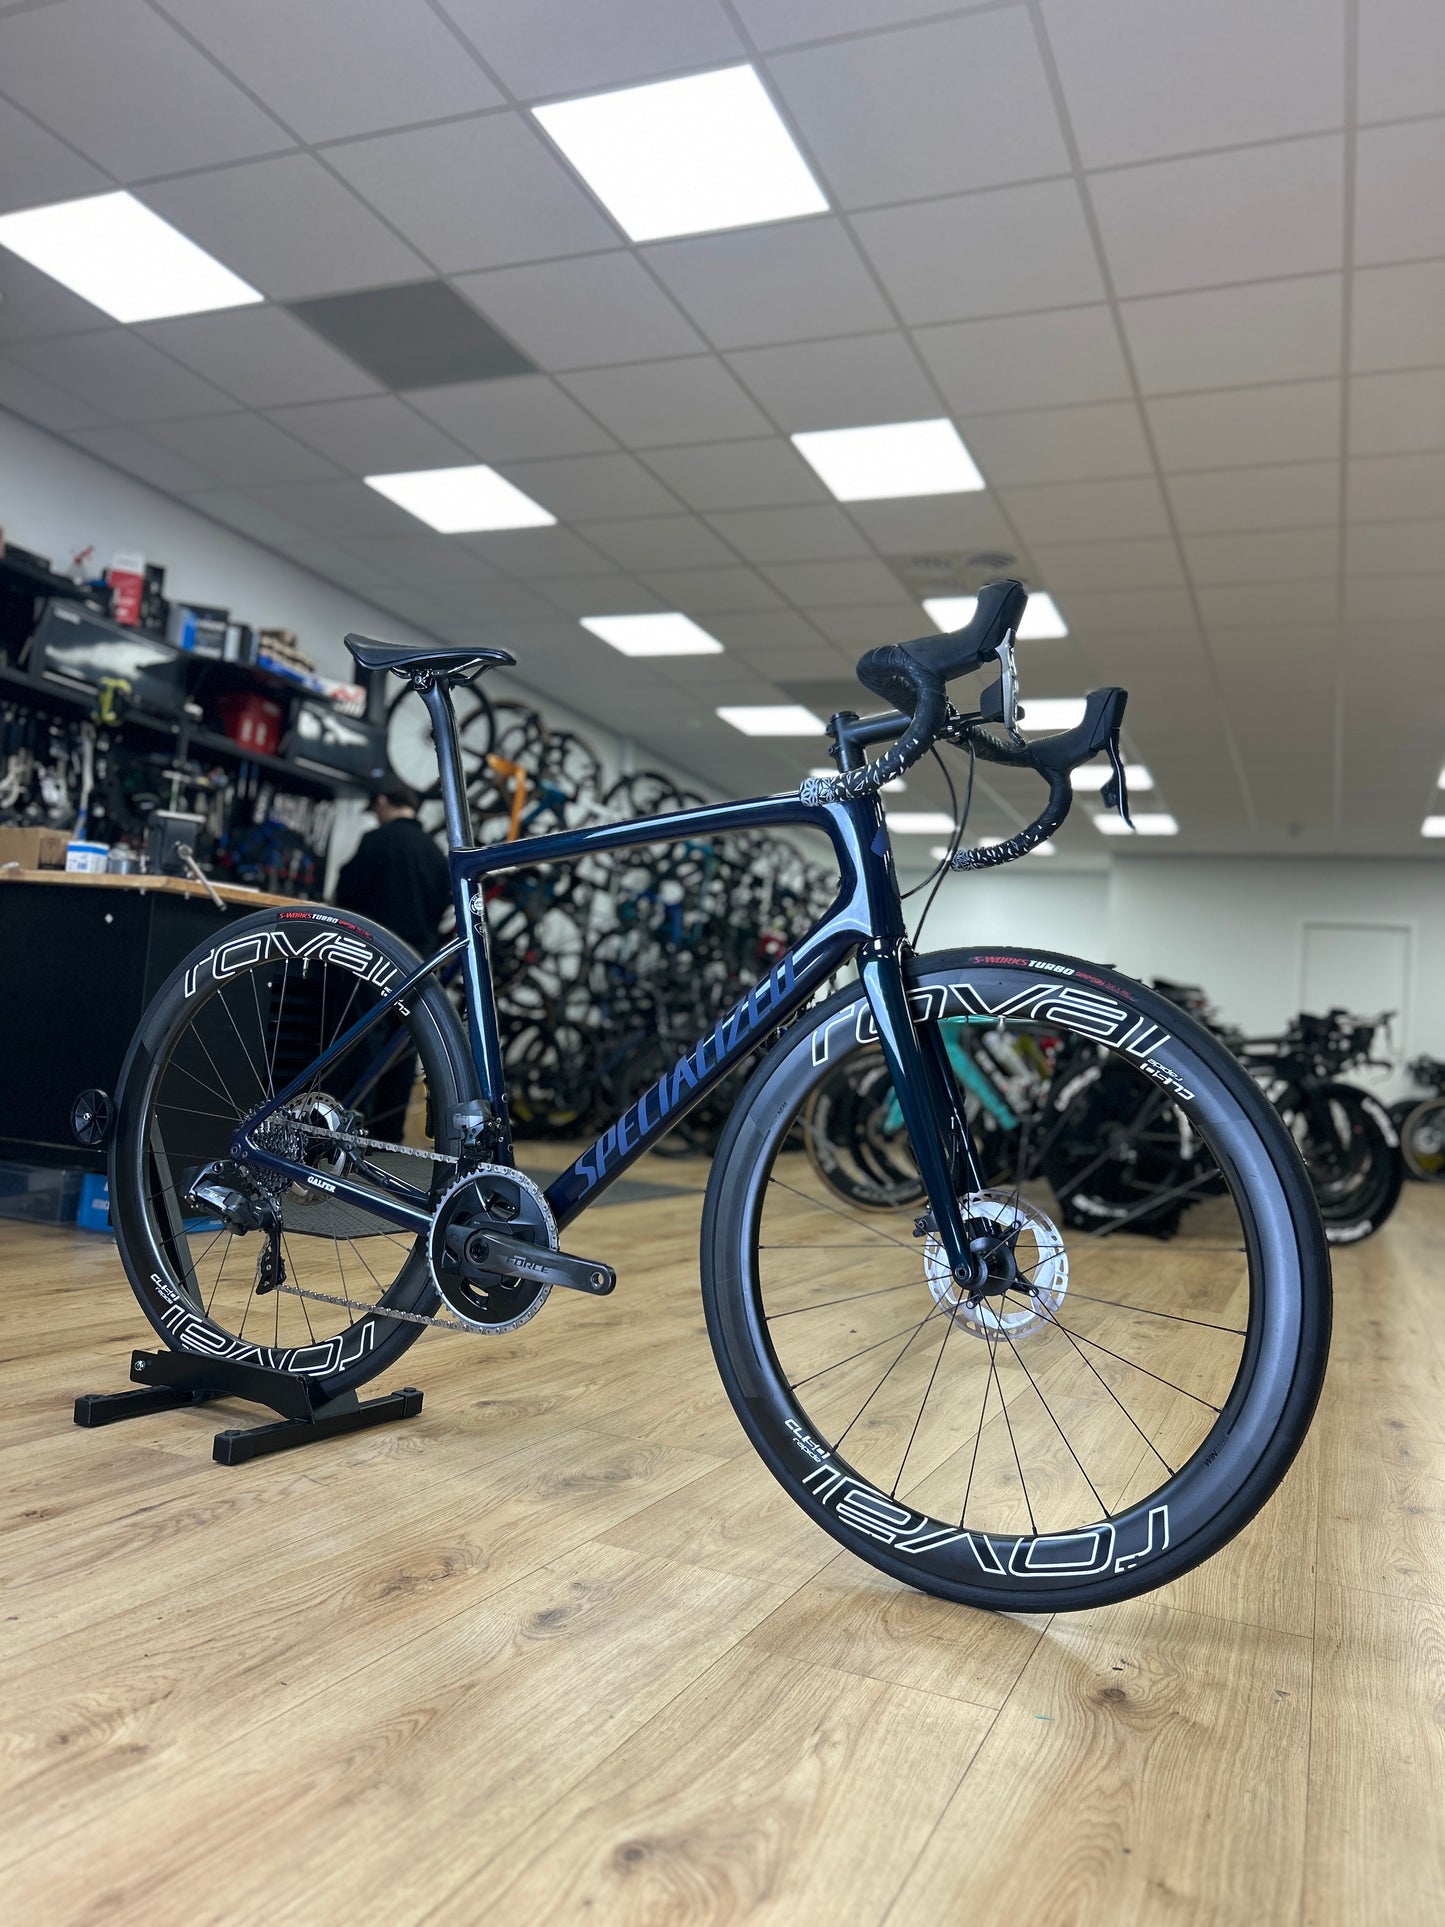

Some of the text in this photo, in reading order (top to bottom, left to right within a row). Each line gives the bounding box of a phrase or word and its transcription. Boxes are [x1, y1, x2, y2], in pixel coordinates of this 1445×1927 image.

[279, 912, 312, 920] S-WORKS
[311, 913, 339, 924] TURBO
[973, 956, 1029, 967] S-WORKS
[1028, 959, 1076, 977] TURBO
[574, 950, 796, 1200] SPECIALIZED
[307, 1176, 337, 1194] GALFER
[506, 1256, 550, 1275] FORCE
